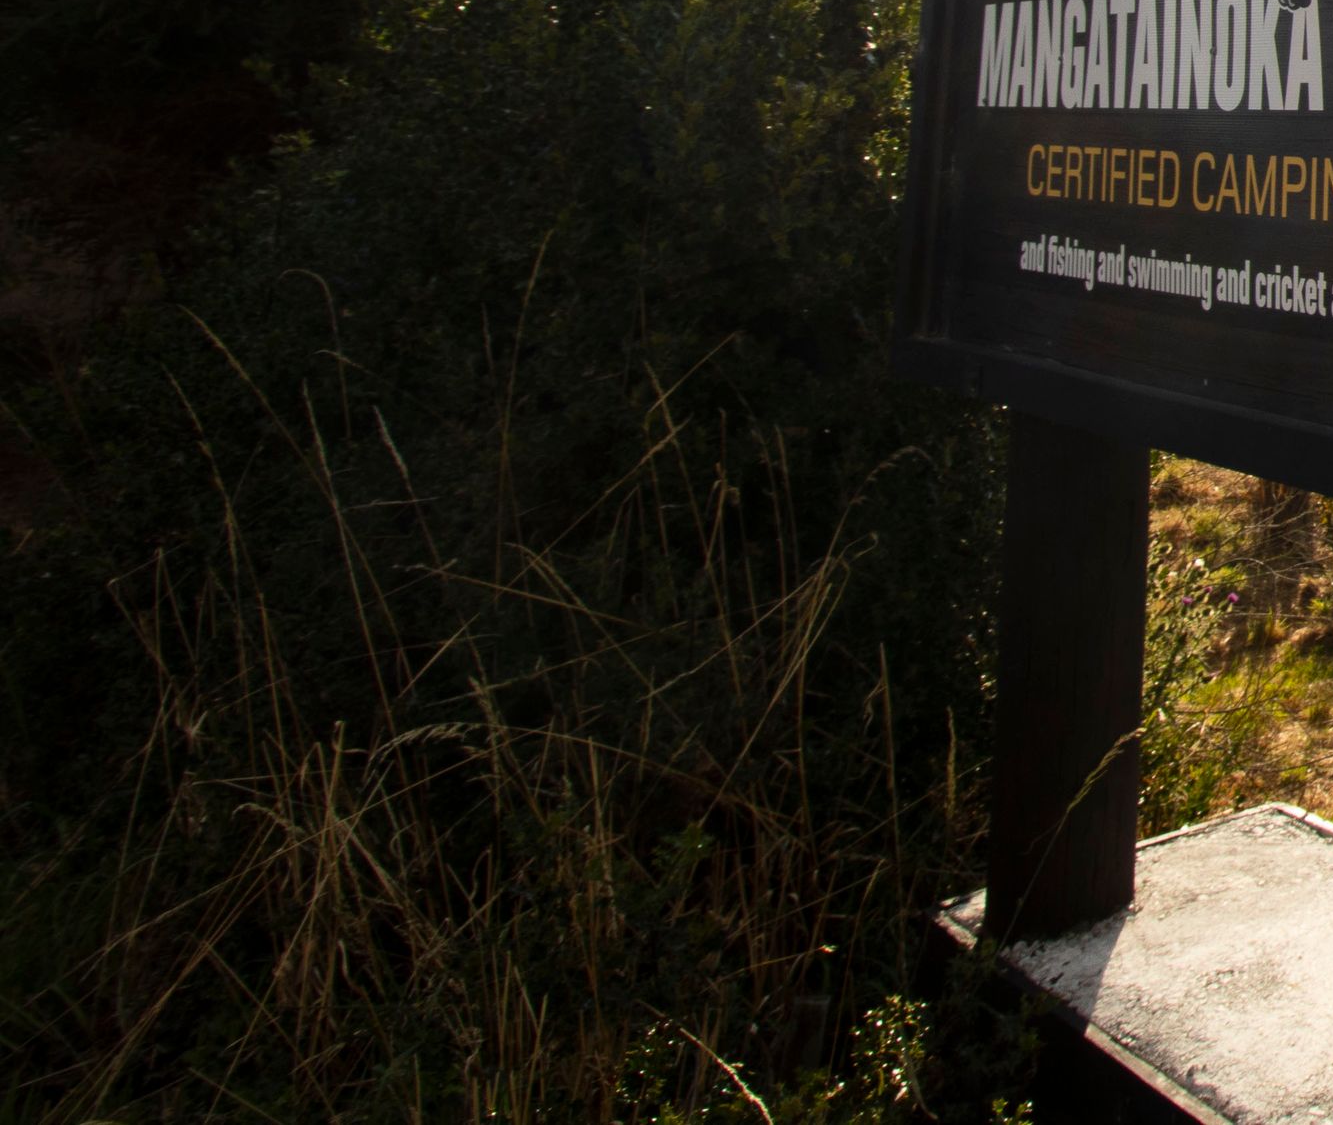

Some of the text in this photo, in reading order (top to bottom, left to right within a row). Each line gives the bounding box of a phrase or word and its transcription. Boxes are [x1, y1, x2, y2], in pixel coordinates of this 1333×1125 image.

[1026, 143, 1181, 208] CERTIFIED
[1019, 233, 1047, 273] and
[1047, 234, 1095, 292] fishing
[1097, 243, 1126, 286] and
[1127, 249, 1213, 311] swimming
[1216, 259, 1251, 306] and
[1254, 264, 1327, 317] cricket
